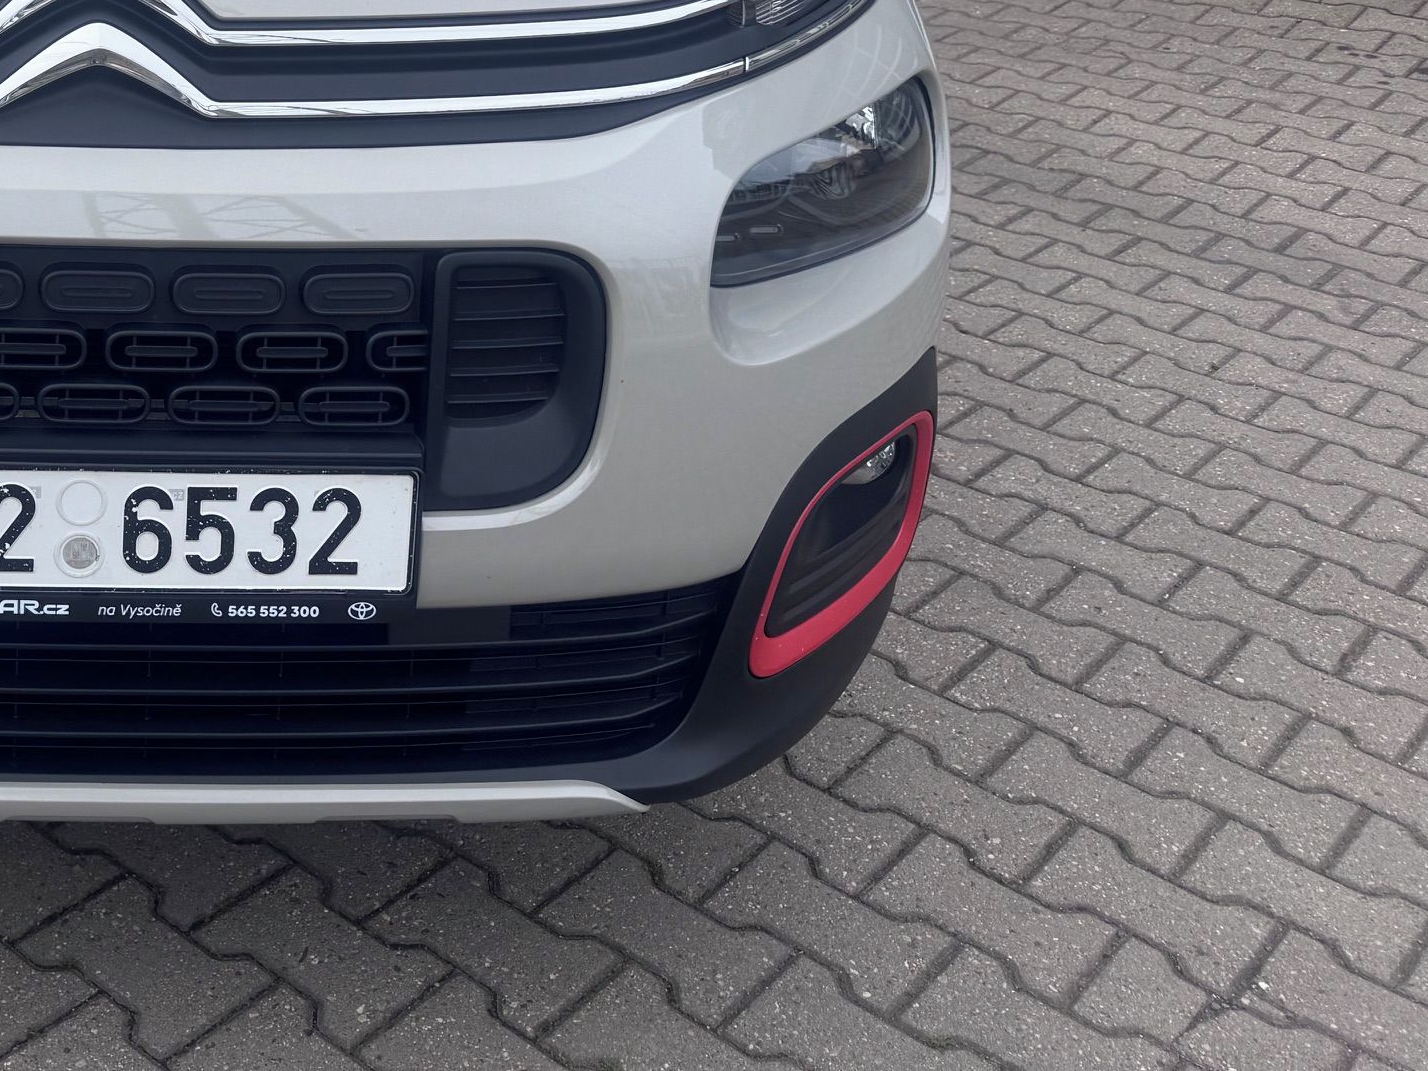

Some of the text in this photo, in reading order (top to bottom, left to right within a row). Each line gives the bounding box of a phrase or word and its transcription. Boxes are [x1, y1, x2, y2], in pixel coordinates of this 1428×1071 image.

[123, 486, 362, 575] 6532
[97, 605, 115, 616] na
[121, 603, 182, 619] Vysočině
[227, 605, 256, 617] 565
[259, 605, 287, 617] 552
[290, 606, 320, 618] 300
